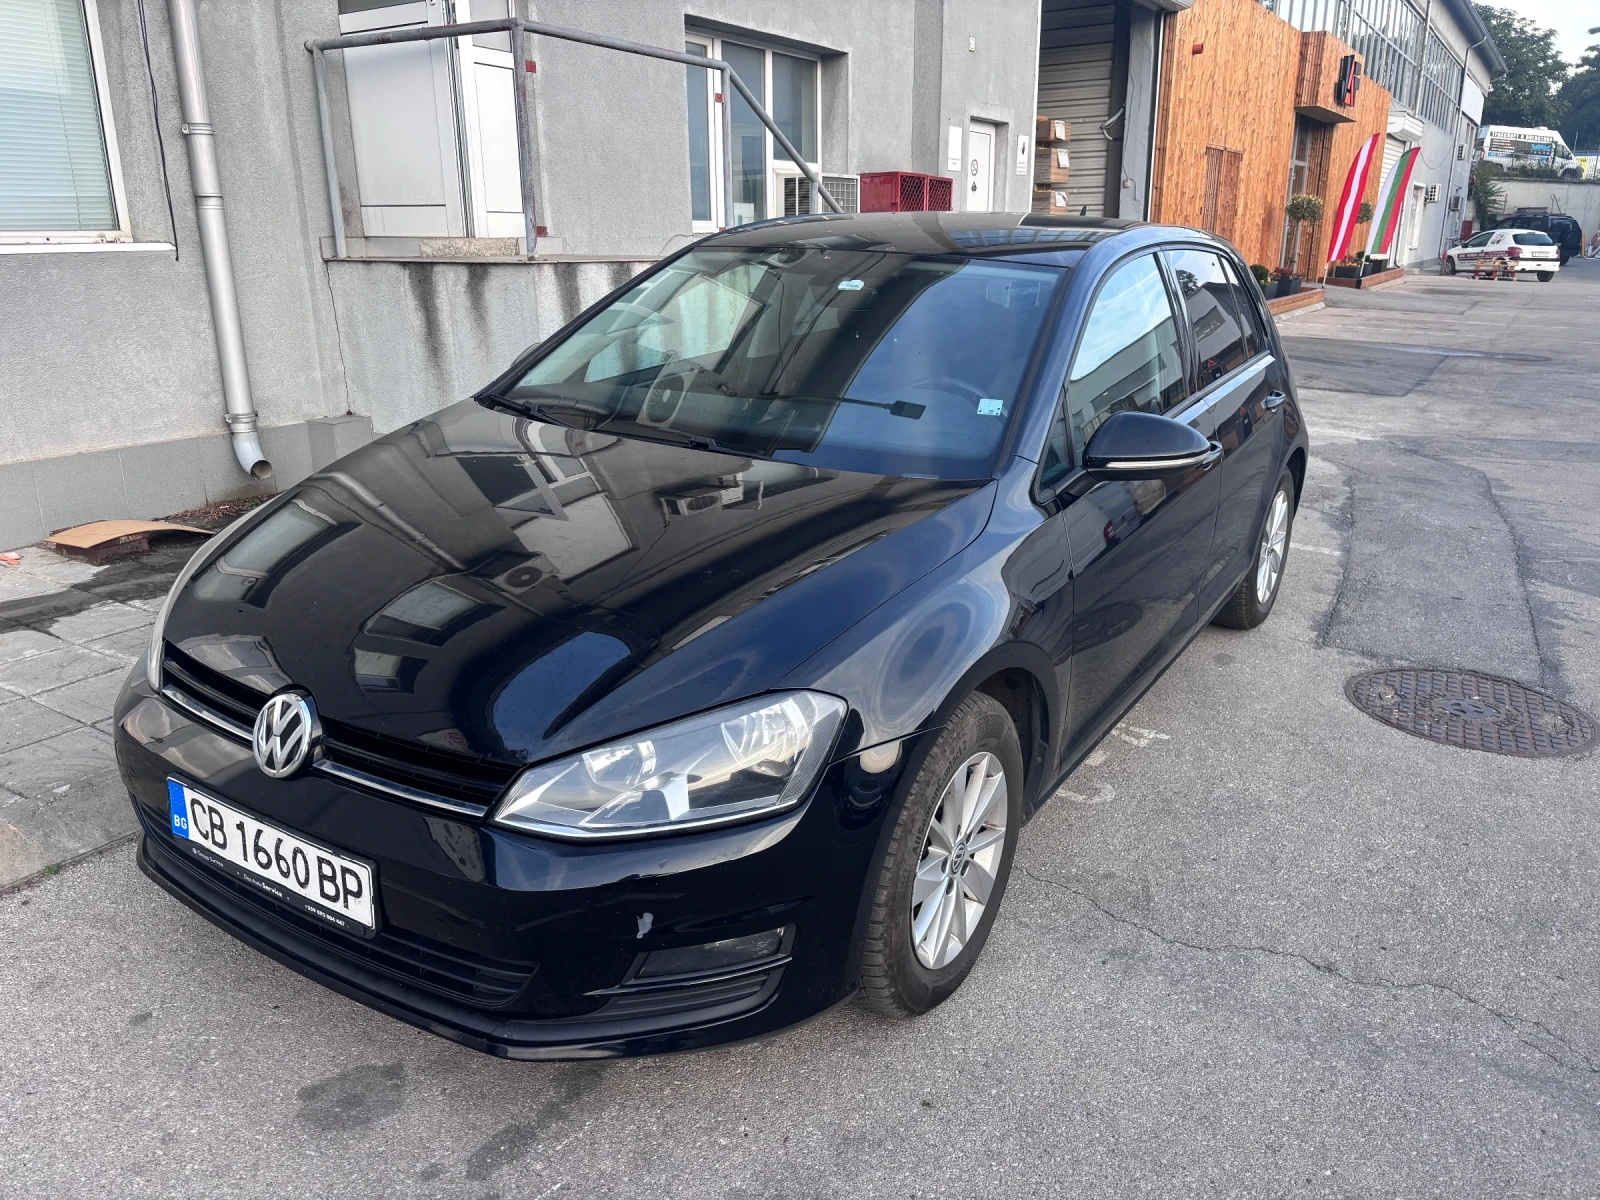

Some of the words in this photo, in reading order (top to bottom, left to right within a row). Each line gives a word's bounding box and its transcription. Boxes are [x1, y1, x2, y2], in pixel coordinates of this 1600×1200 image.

[173, 814, 189, 831] BG
[190, 797, 228, 850] CB
[235, 820, 310, 889] 1660
[316, 854, 363, 909] BP
